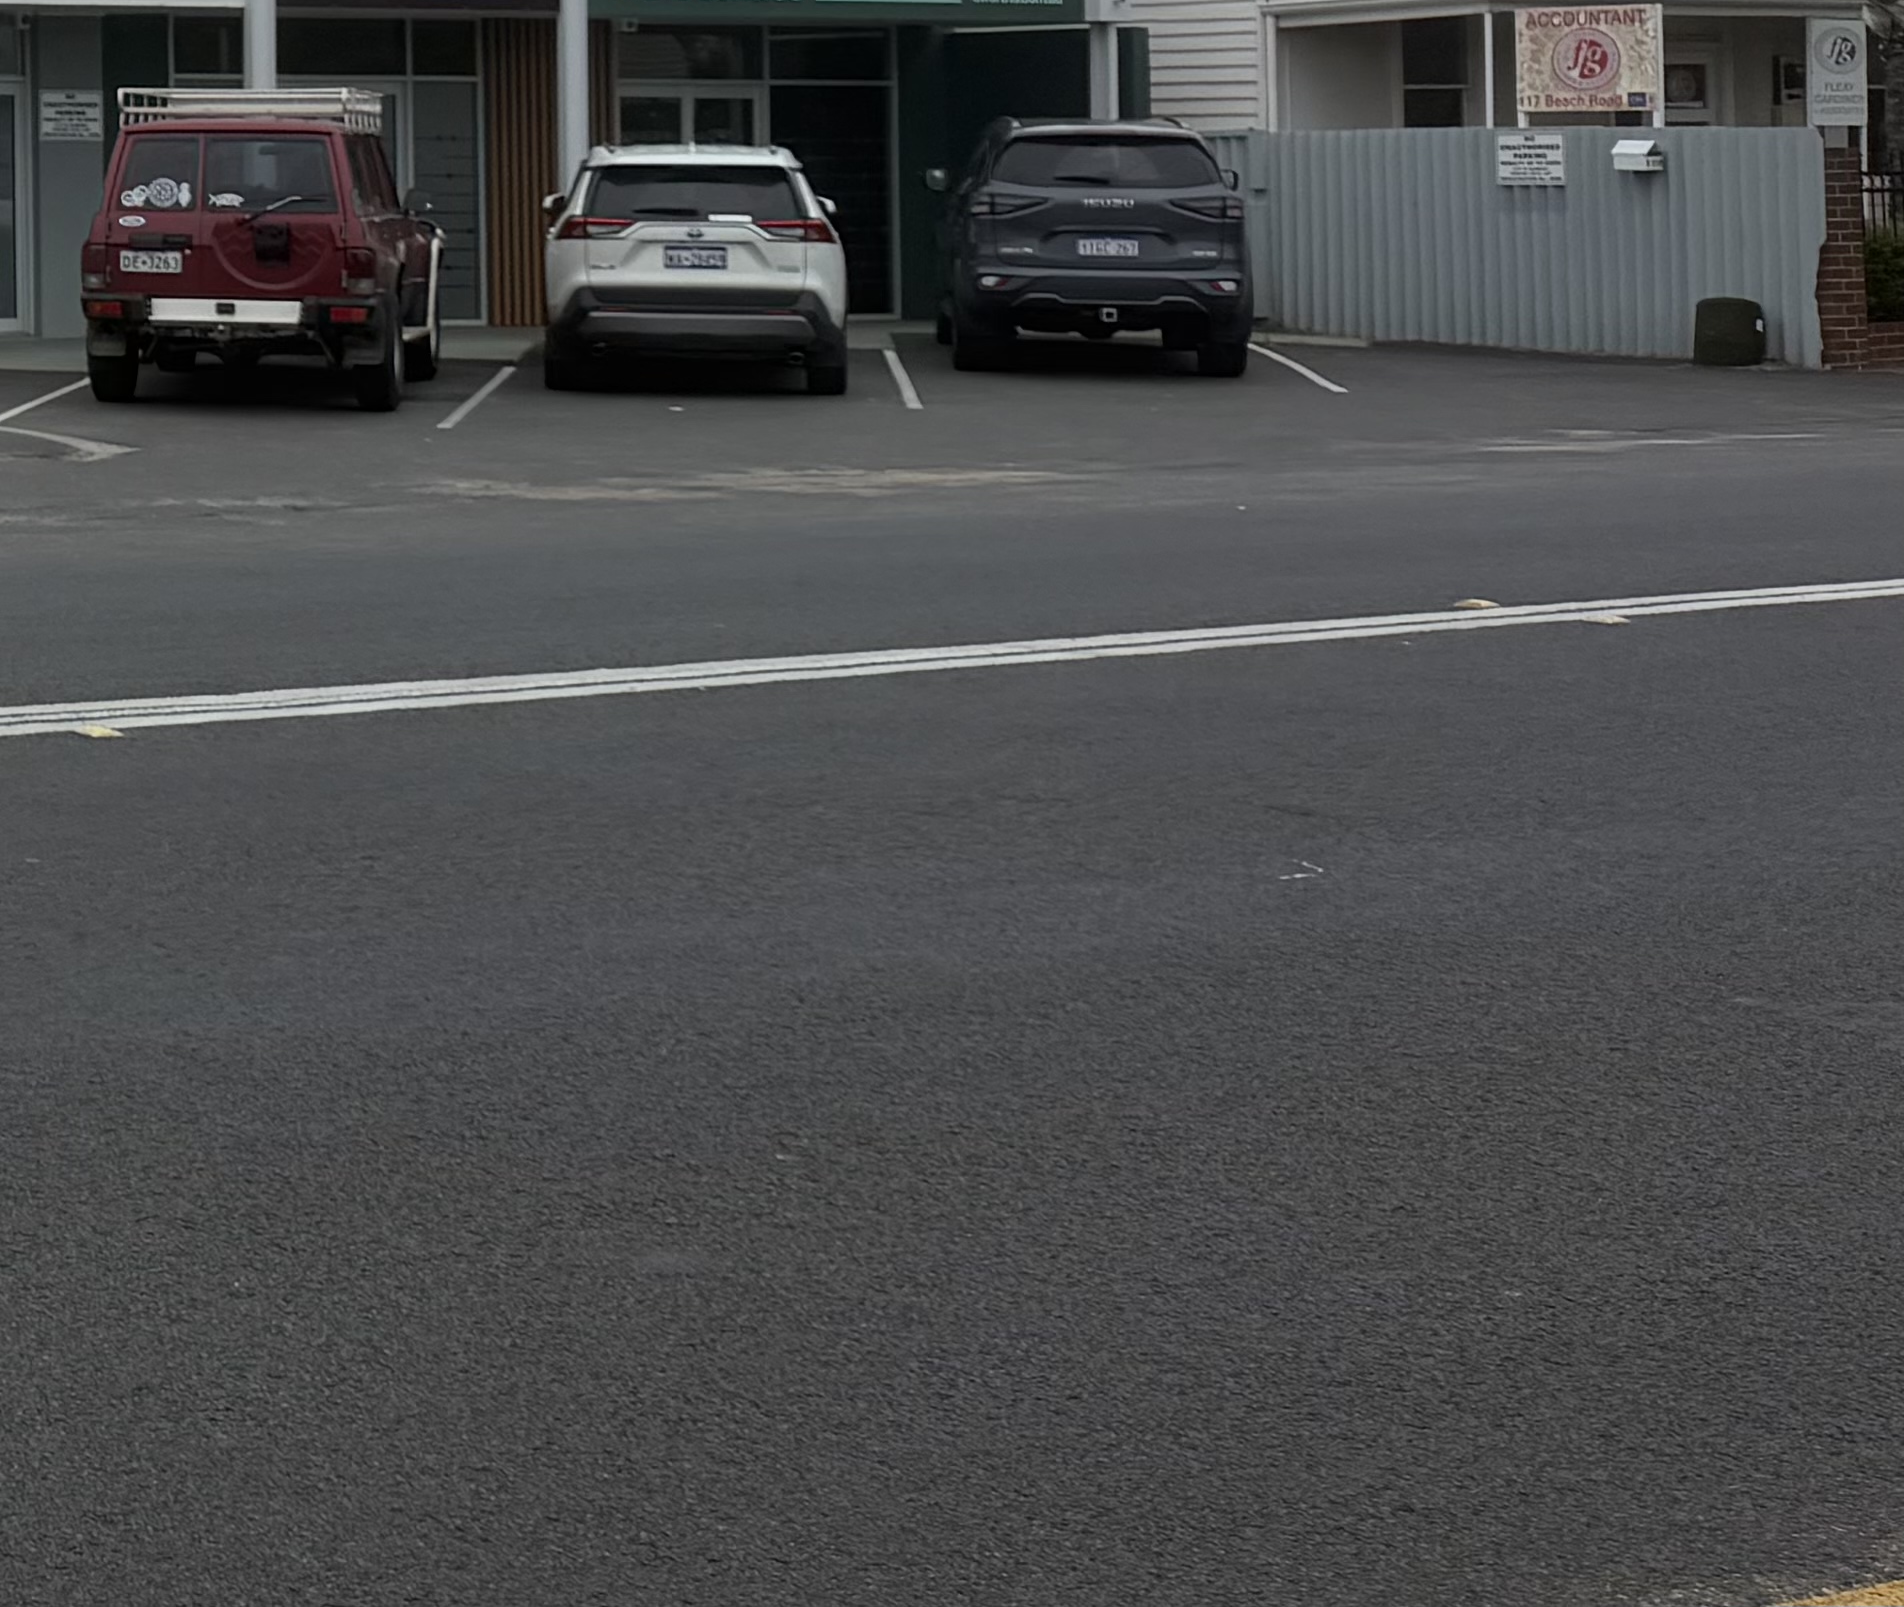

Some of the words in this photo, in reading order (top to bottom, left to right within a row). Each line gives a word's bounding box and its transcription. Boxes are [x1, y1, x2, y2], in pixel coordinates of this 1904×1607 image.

[1525, 8, 1647, 31] ACCOUNTANT
[1545, 94, 1585, 107] Beach
[1588, 94, 1623, 108] Road
[1082, 197, 1135, 208] ISUZU
